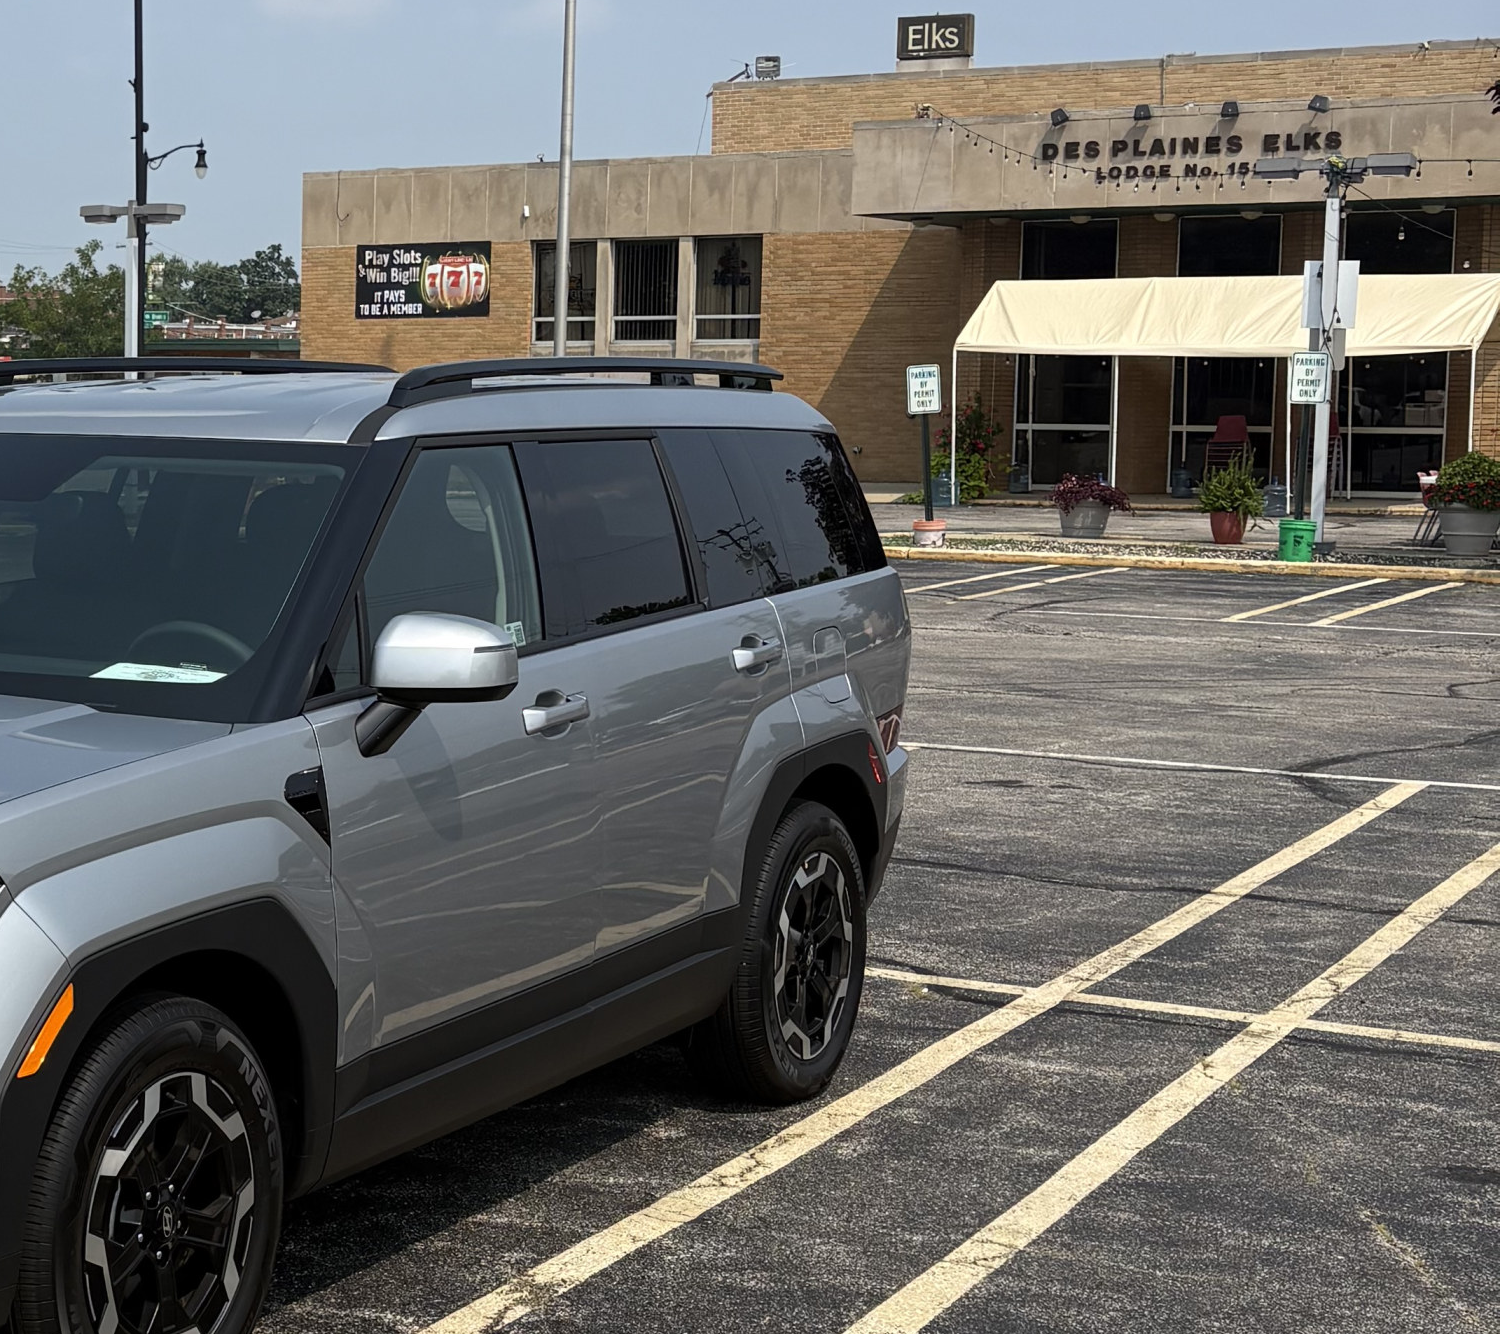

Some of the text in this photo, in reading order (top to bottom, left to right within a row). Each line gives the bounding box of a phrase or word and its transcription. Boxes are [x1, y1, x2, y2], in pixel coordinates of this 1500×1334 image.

[907, 22, 959, 50] Elks
[1042, 131, 1342, 160] DES PLAINES ELKS
[1096, 165, 1171, 180] LODGE
[1185, 164, 1218, 177] No.
[365, 249, 422, 267] Play Slots
[358, 264, 420, 285] & Win Big!!!
[447, 270, 463, 287] 7
[374, 290, 406, 302] IT PAYS
[360, 303, 423, 315] TO BE A MEMBER
[1295, 357, 1325, 366] PARKING
[911, 370, 936, 379] PARKING
[1305, 368, 1314, 377] BY
[1297, 378, 1321, 387] PERMIT
[914, 389, 935, 398] PERMIT
[1299, 389, 1317, 398] ONLY
[917, 400, 932, 408] ONLY
